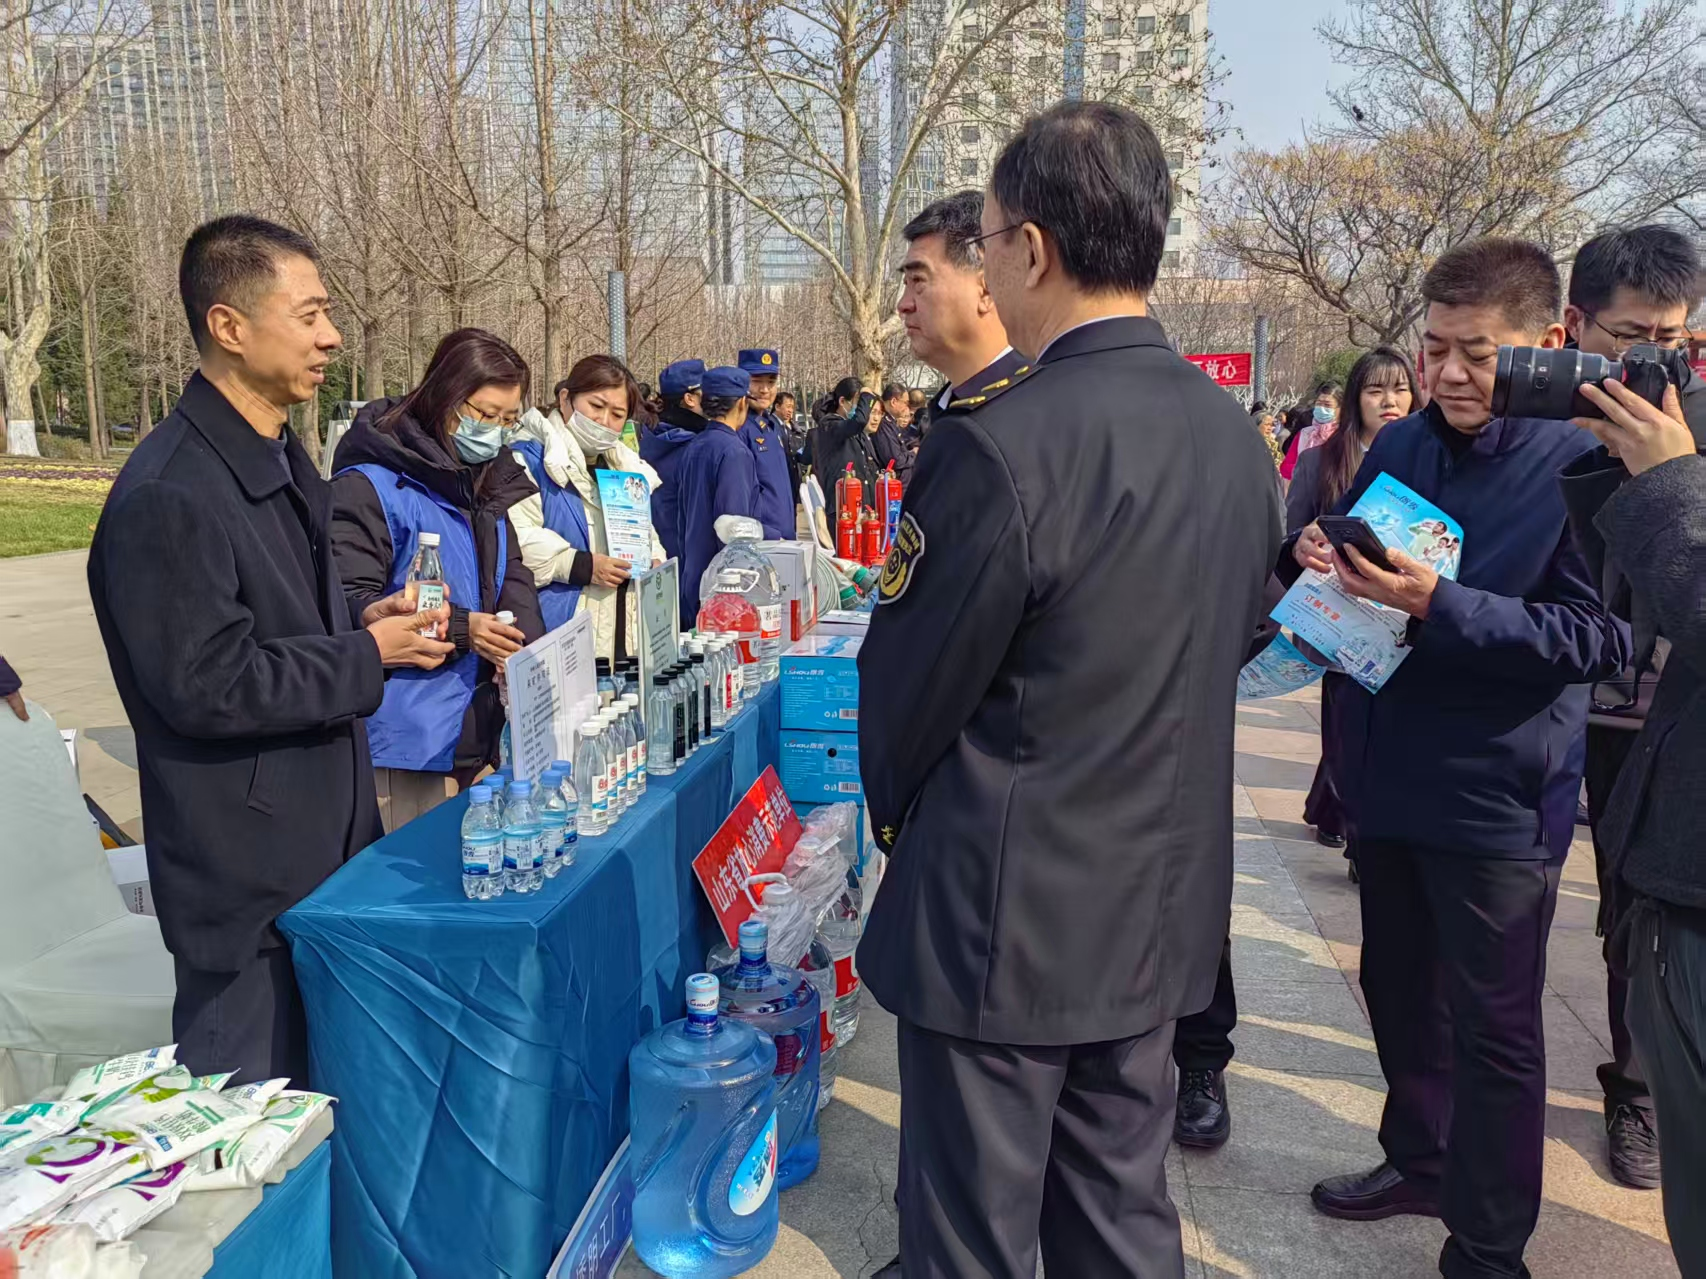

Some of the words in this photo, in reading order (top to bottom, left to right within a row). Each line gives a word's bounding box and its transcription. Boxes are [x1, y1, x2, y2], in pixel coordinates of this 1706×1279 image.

[1192, 359, 1237, 380] 放心
[710, 785, 791, 913] 山东省放心消费示范单位
